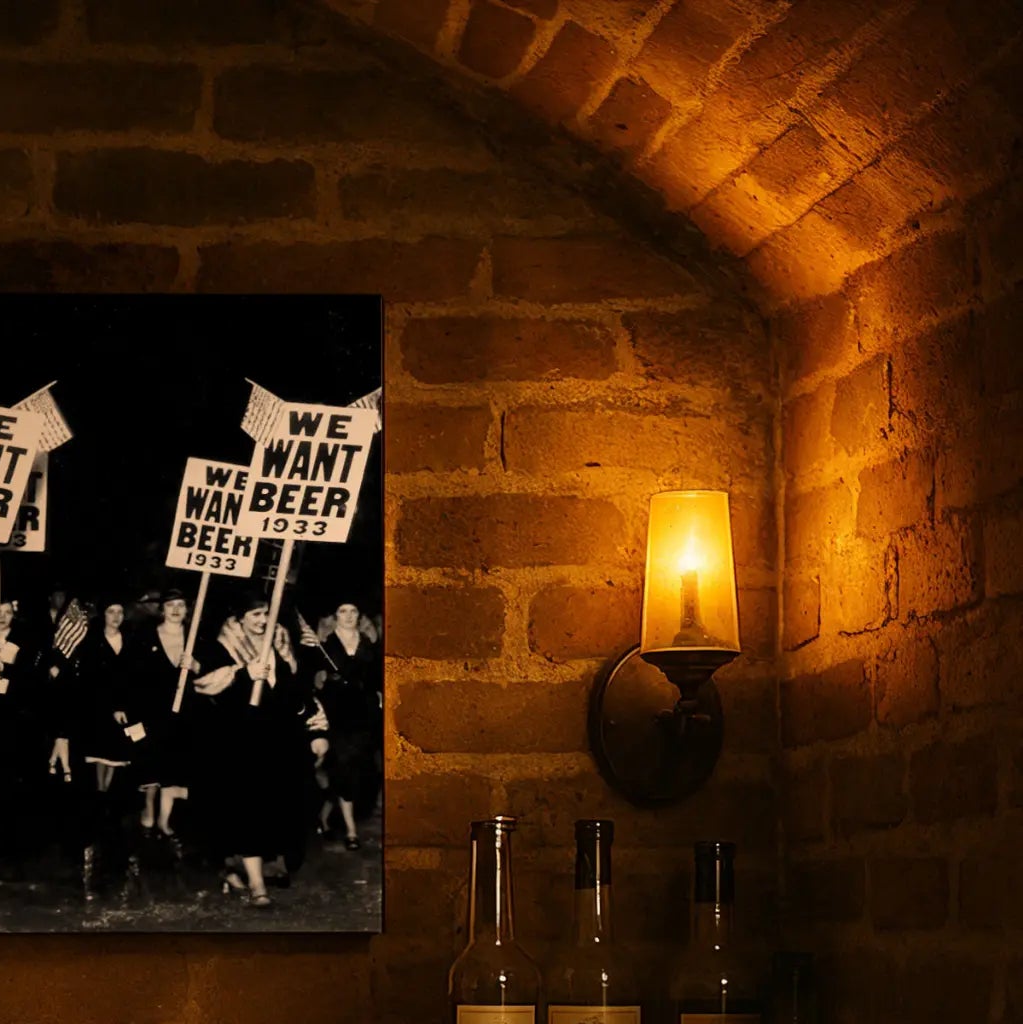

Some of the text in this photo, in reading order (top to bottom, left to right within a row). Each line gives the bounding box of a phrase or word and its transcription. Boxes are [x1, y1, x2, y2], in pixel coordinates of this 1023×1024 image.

[289, 411, 352, 439] WE
[261, 438, 363, 483] WANT
[205, 466, 249, 491] WE
[186, 486, 244, 526] WAN
[249, 482, 351, 518] BEER
[176, 521, 253, 557] BEER
[262, 517, 328, 536] 1933
[186, 552, 237, 571] 1933
